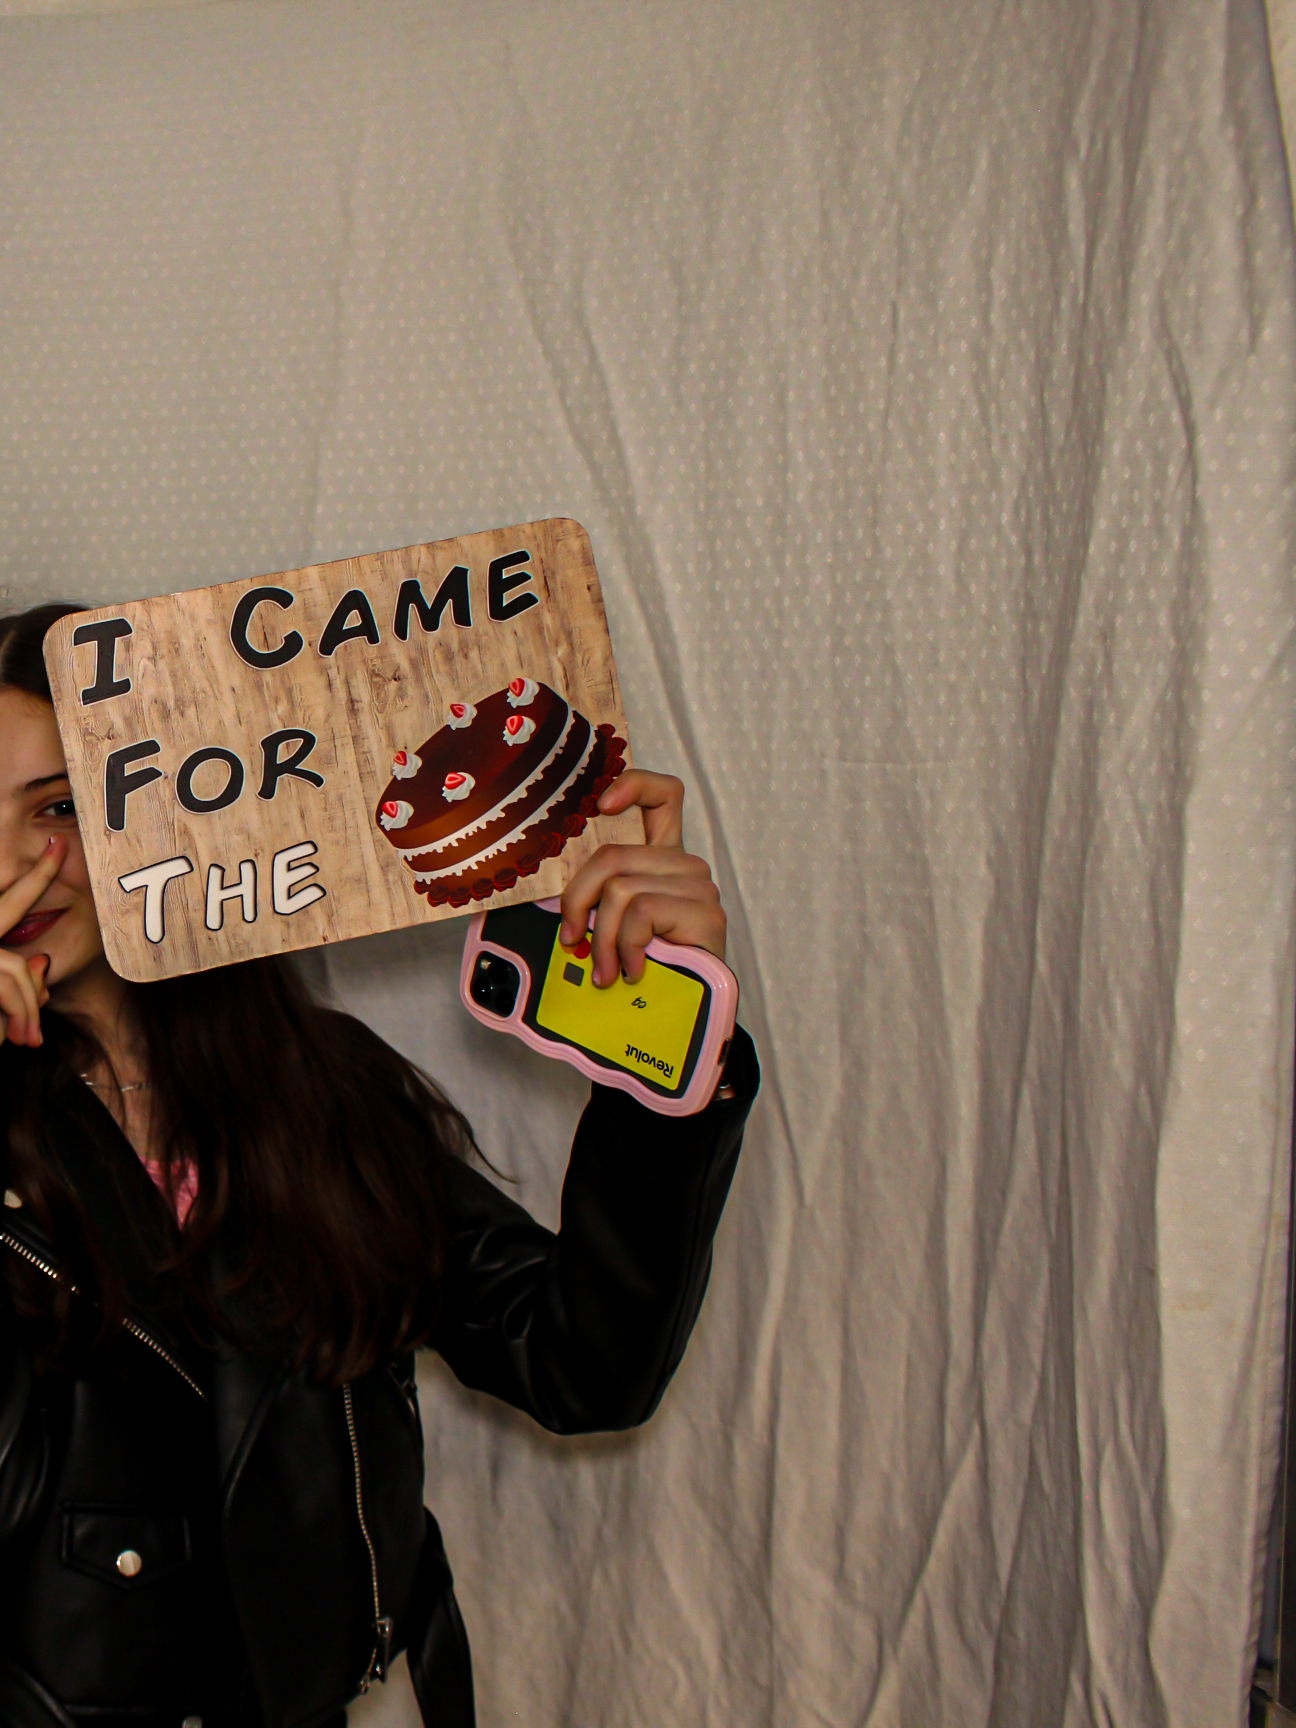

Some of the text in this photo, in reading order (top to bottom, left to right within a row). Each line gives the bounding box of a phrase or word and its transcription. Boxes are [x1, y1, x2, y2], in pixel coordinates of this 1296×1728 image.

[73, 549, 539, 706] I CAME
[105, 728, 324, 832] FOR
[118, 840, 326, 943] THE
[625, 1044, 674, 1079] Revolut
